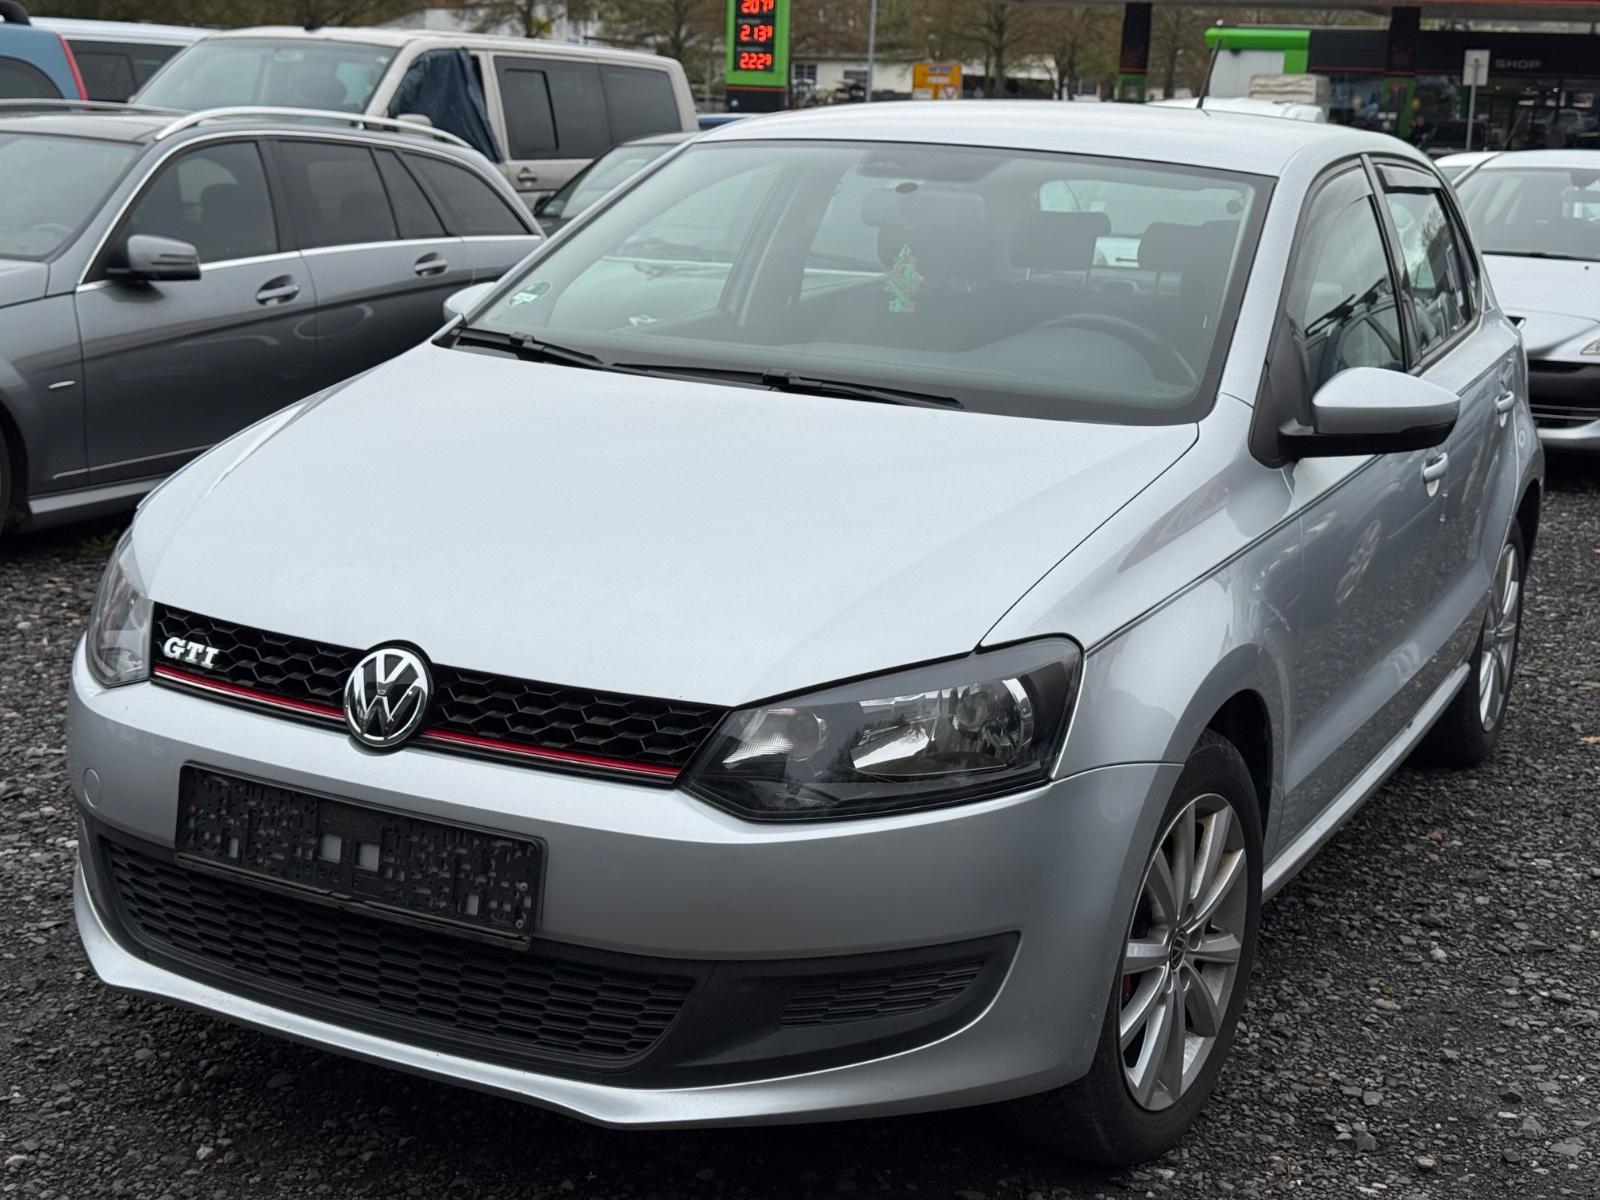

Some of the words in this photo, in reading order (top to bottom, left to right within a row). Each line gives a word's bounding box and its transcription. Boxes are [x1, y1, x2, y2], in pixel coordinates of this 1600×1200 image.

[1495, 58, 1542, 70] SHOP
[163, 636, 220, 671] GTI
[345, 647, 430, 748] VW
